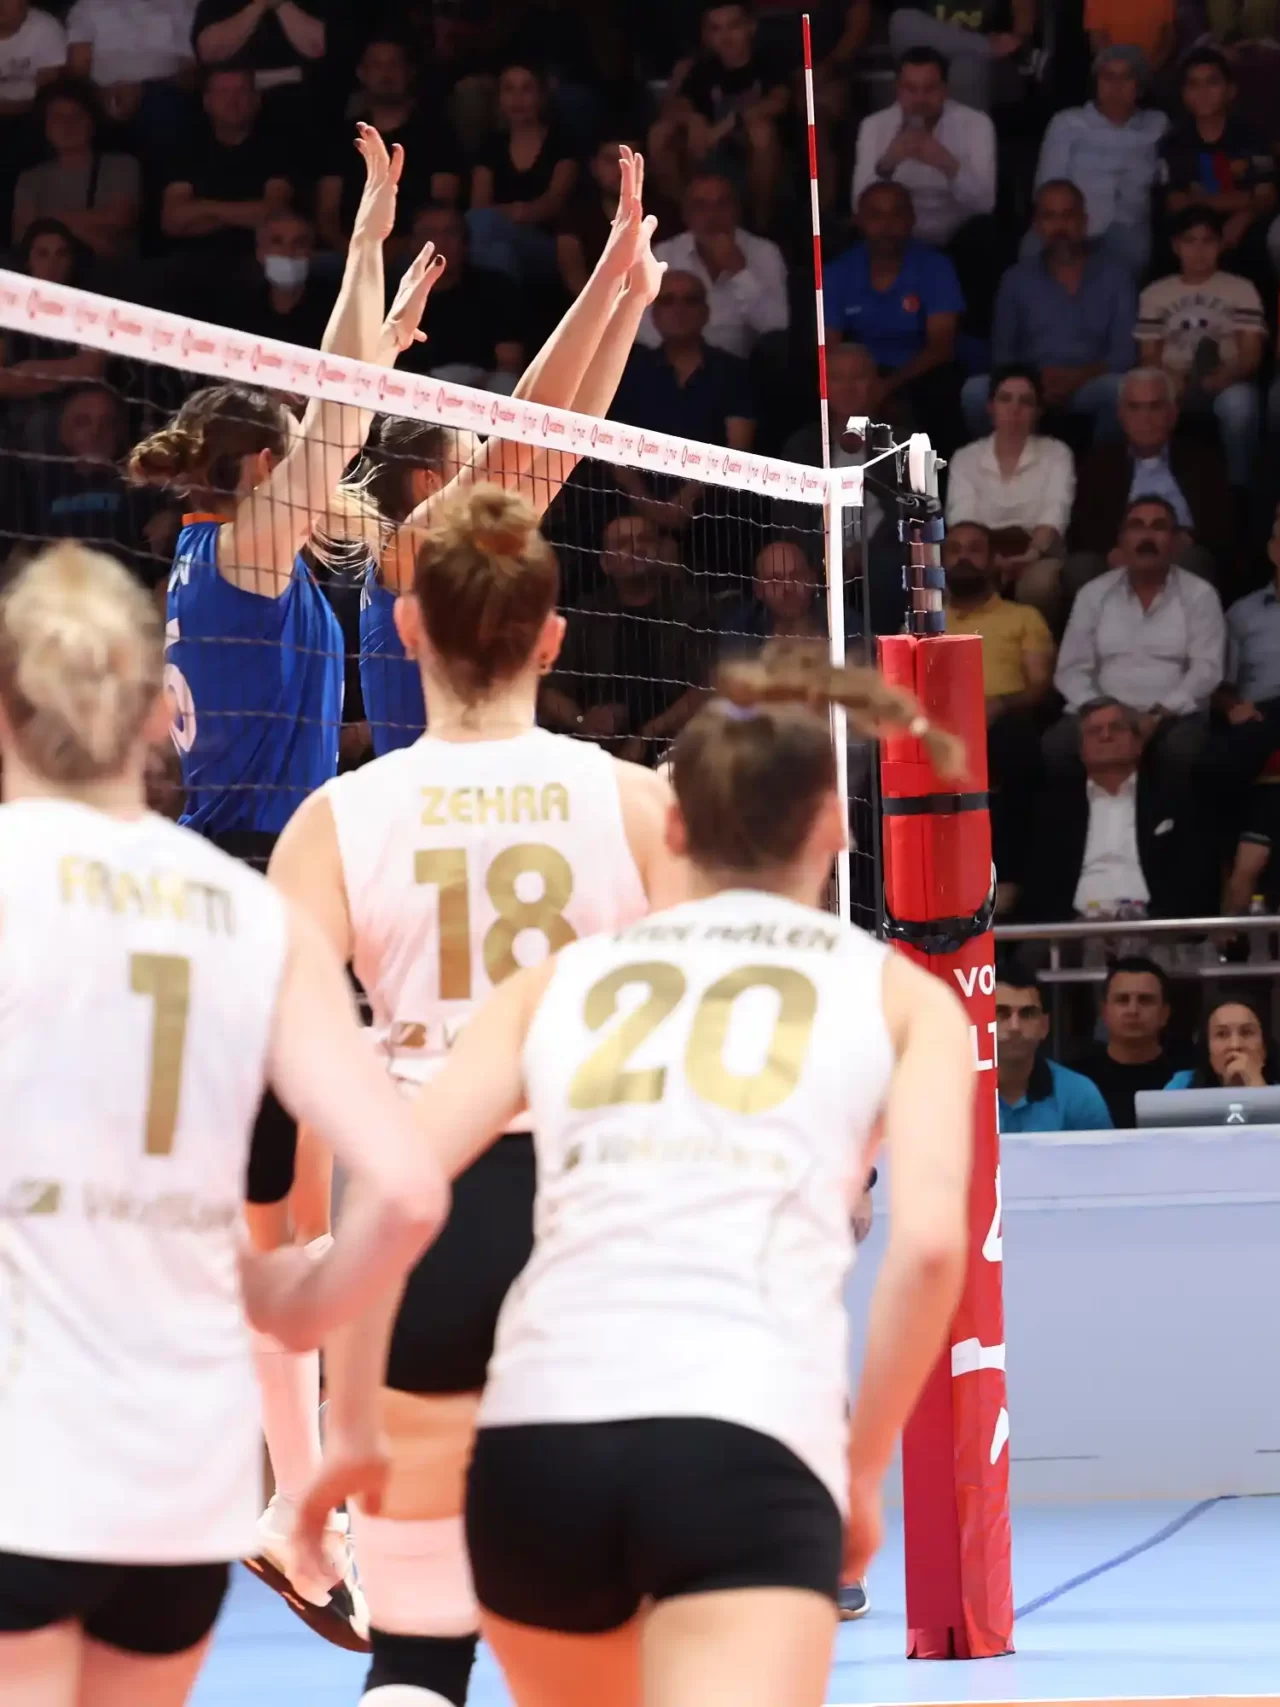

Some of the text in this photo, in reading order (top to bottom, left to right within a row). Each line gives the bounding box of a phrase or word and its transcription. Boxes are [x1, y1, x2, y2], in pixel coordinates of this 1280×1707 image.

[420, 782, 570, 827] ZEHRA
[413, 843, 578, 1001] 18
[953, 962, 997, 998] VO
[130, 952, 191, 1156] 1
[567, 960, 819, 1115] 20
